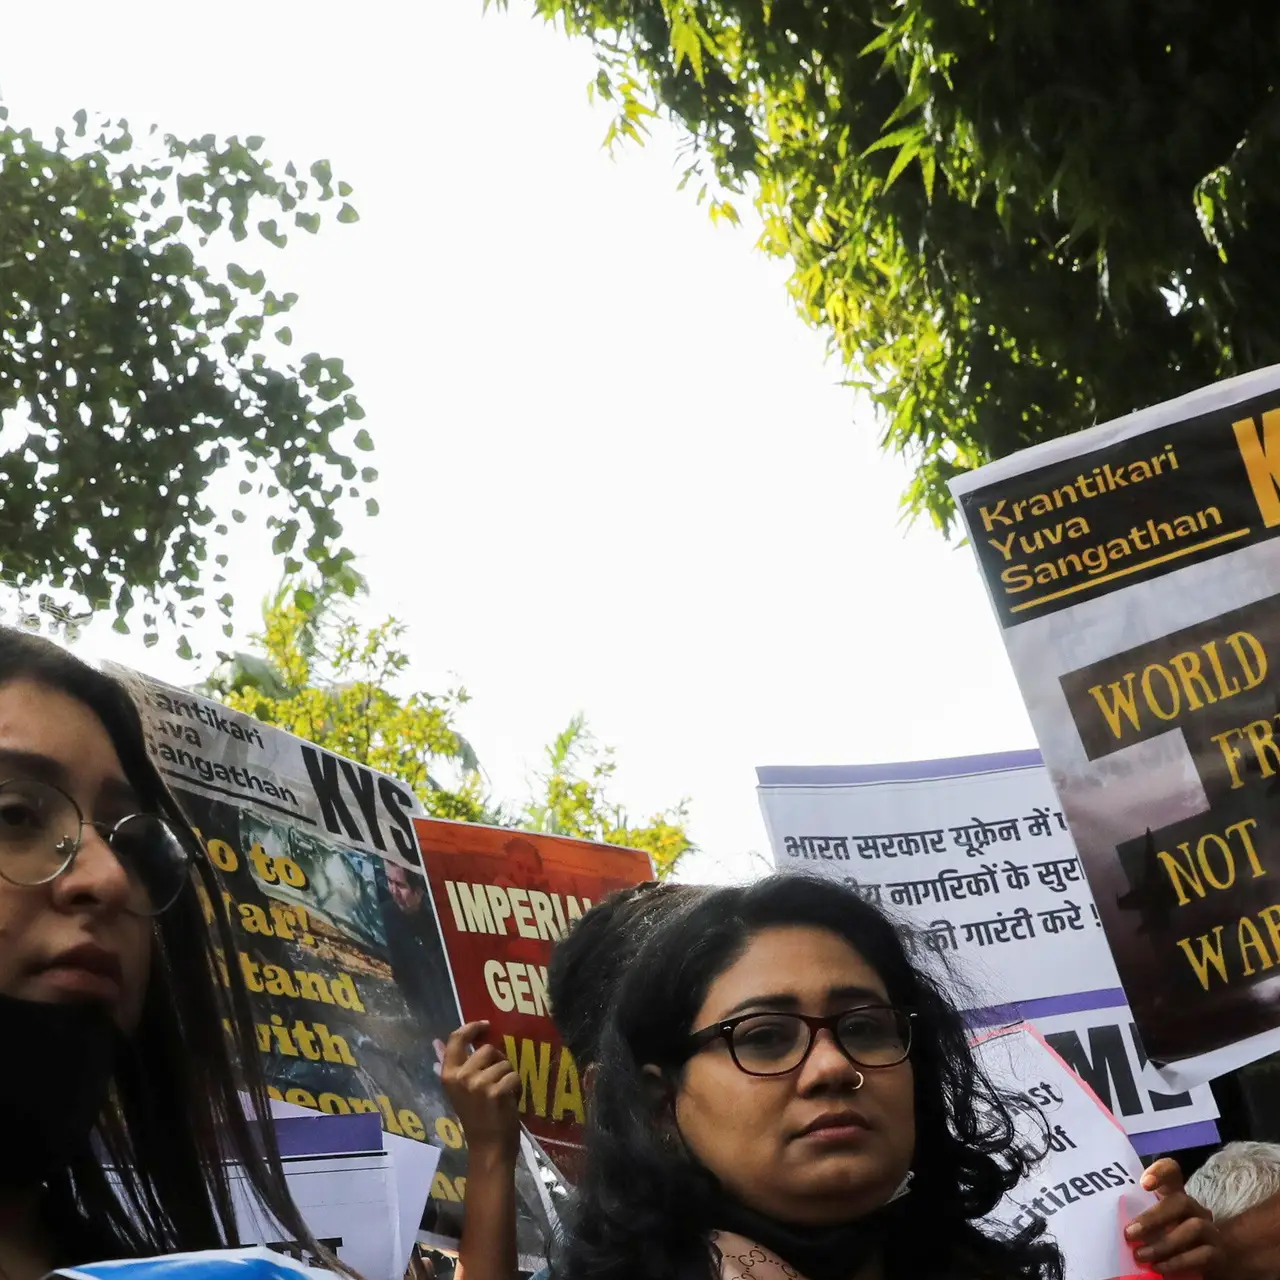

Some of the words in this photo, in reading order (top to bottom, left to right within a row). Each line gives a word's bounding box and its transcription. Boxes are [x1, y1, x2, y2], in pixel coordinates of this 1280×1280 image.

[979, 445, 1180, 532] Krantikari
[989, 517, 1090, 562] Yuva
[1000, 505, 1223, 594] Sangathan
[1089, 632, 1269, 739] WORLD
[158, 718, 203, 748] va
[155, 692, 265, 750] antikari
[300, 745, 421, 867] KYS
[191, 827, 239, 872] o
[250, 842, 308, 888] to
[784, 836, 850, 861] भारत
[853, 830, 946, 858] सरकार
[949, 817, 1021, 857] यूक्रेन
[1023, 808, 1052, 836] में
[1157, 819, 1266, 907] NOT
[886, 863, 999, 905] नागरिकों
[1002, 860, 1030, 890] के
[1033, 855, 1086, 891] सुर
[444, 880, 593, 942] IMPERIA
[961, 907, 1035, 947] गारंटी
[1038, 900, 1084, 934] करे
[484, 959, 551, 1017] GEN
[504, 1034, 586, 1124] WA
[1044, 1022, 1193, 1118] ML
[435, 1116, 468, 1150] o
